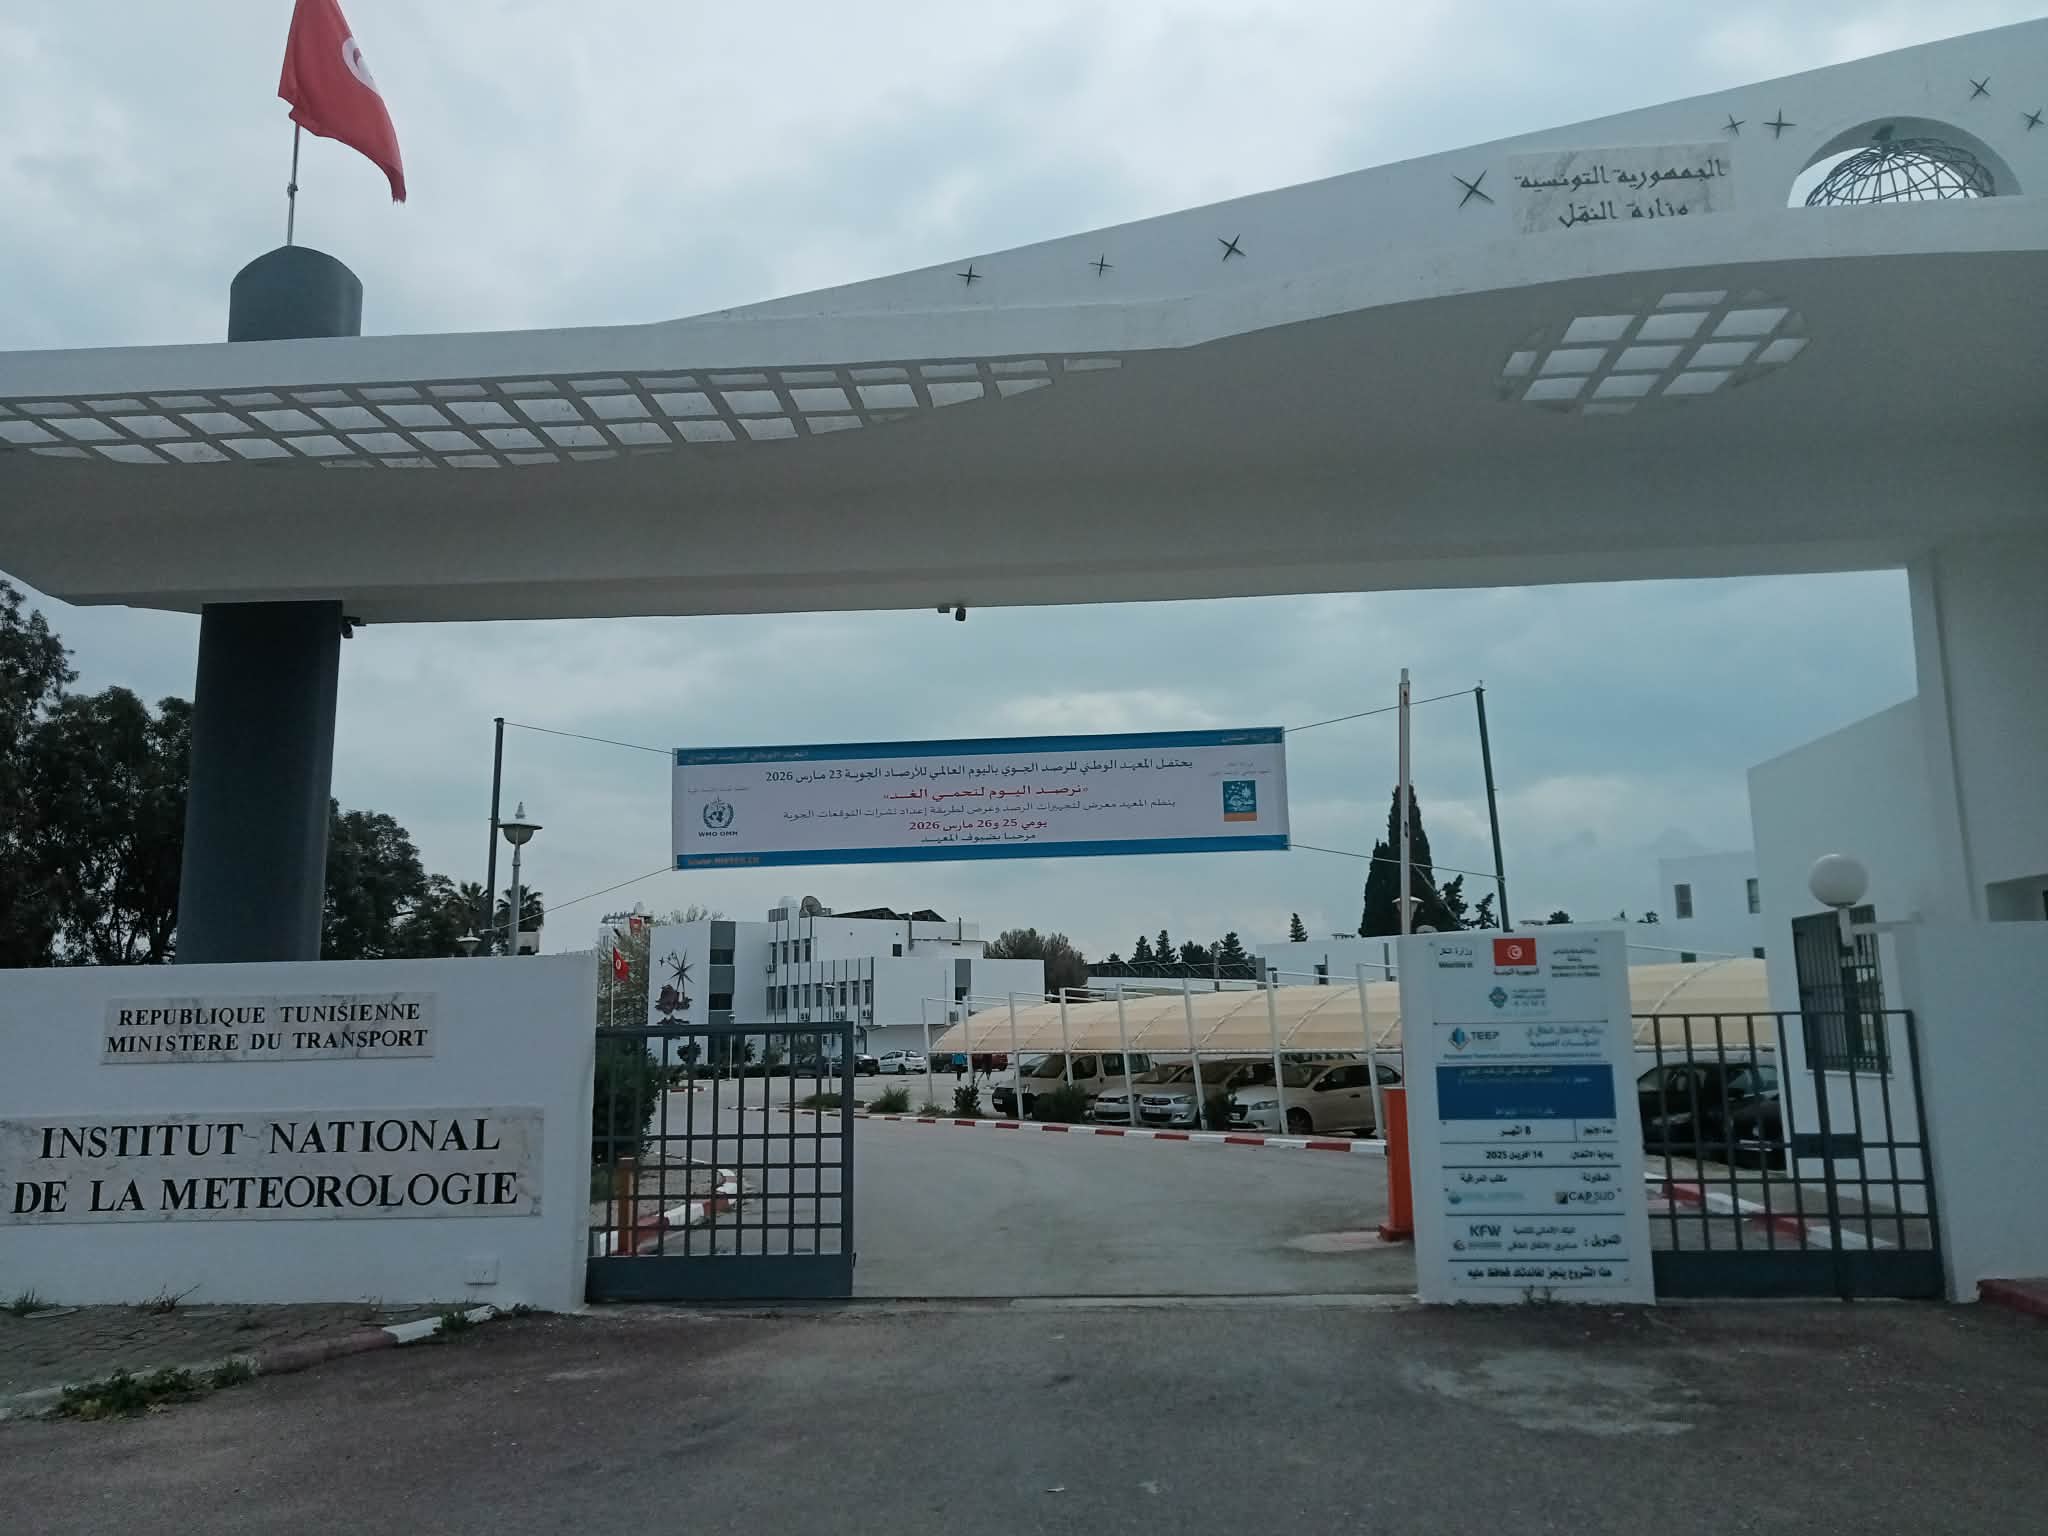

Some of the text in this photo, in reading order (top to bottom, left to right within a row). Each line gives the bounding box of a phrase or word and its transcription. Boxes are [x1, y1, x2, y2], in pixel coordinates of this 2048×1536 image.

[1514, 158, 1726, 192] الجمهورية التونسية
[1558, 200, 1619, 228] النقل
[766, 758, 1193, 784] يحتفل المعهد الوطني للرصد الجوي باليوم العالمي للأرصاد الجوية 23 مارس 2026
[932, 786, 985, 801] لنحمي
[989, 785, 1031, 799] اليوم
[1002, 803, 1034, 812] الرصد
[909, 818, 1048, 832] يومي 25 و26 مارس 2026
[118, 1003, 420, 1027] REPUBLIQUE TUNISIENNE
[107, 1029, 428, 1053] MINISTERE DU TRANSPORT
[39, 1118, 500, 1159] INSTITUT NATIONAL
[1486, 1151, 1508, 1160] 2025
[1533, 1151, 1543, 1159] 14
[9, 1171, 518, 1215] DE LA METEOROLOGIE
